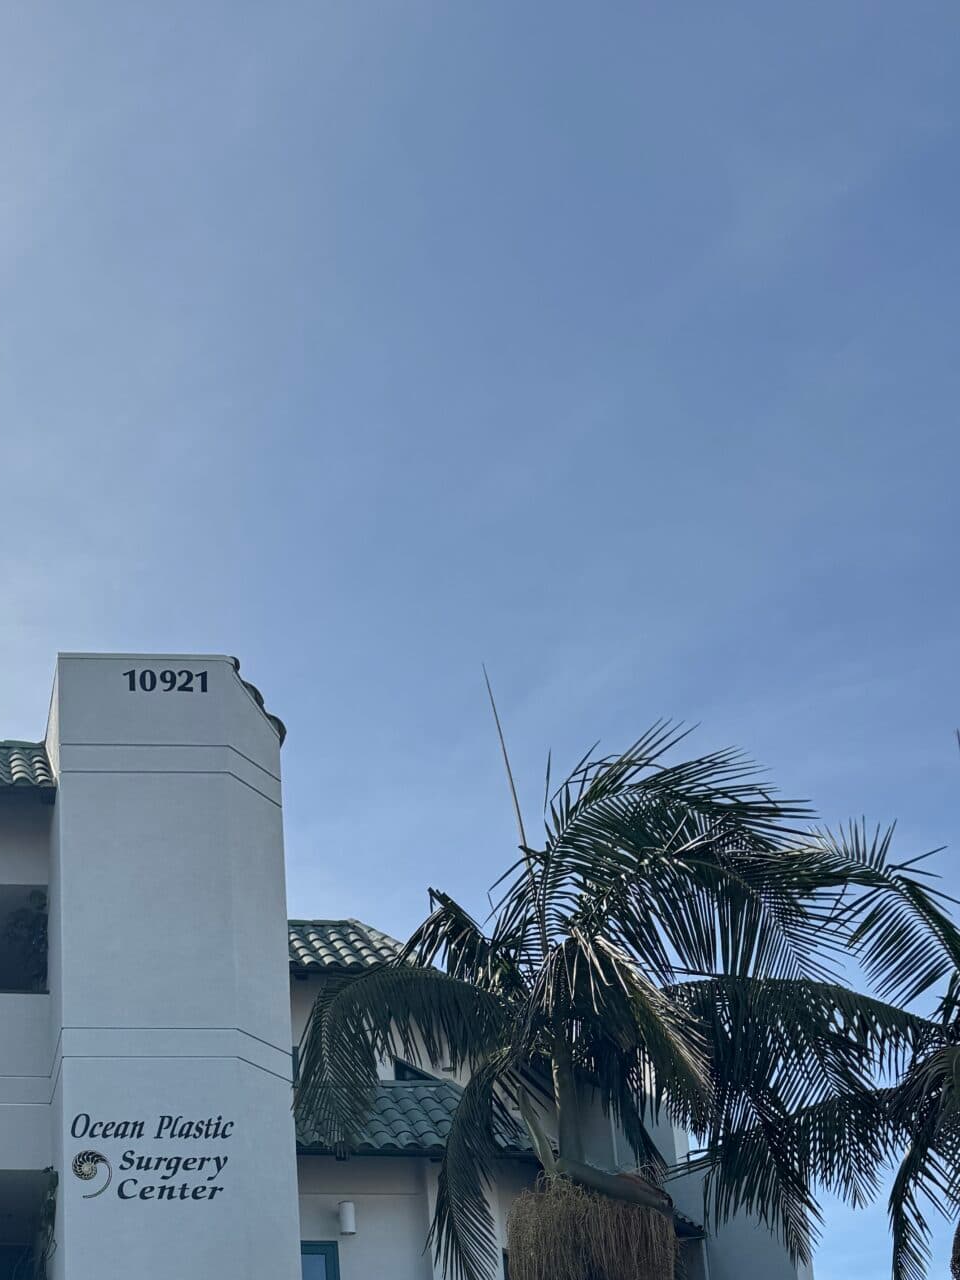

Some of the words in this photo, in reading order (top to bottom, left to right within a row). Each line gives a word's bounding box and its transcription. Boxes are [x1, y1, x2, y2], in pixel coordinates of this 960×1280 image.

[122, 669, 210, 693] 10921
[70, 1113, 145, 1140] Ocean
[153, 1115, 235, 1140] Plastic
[118, 1149, 229, 1180] Surgery
[117, 1177, 224, 1201] Center
